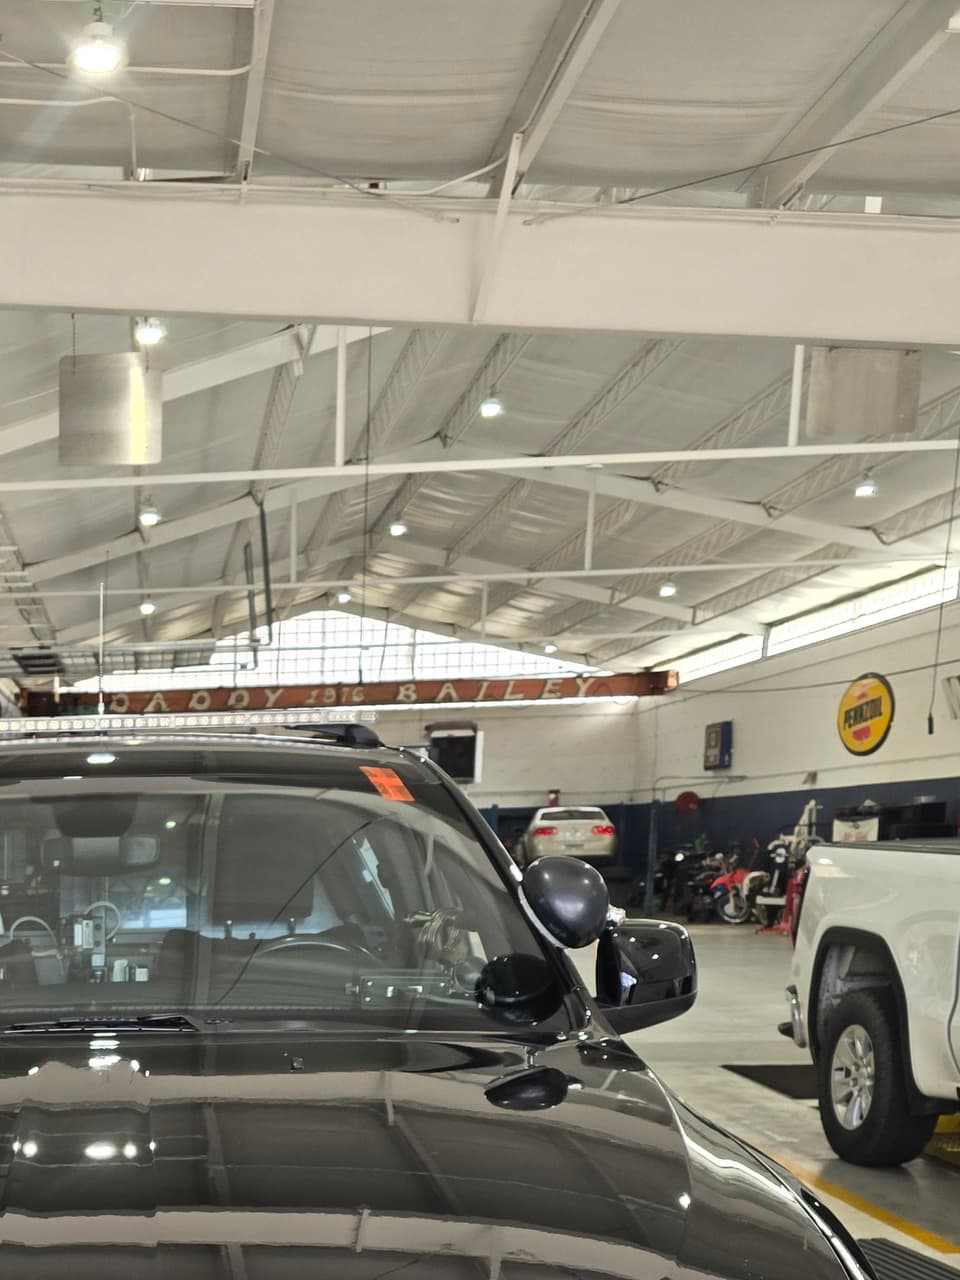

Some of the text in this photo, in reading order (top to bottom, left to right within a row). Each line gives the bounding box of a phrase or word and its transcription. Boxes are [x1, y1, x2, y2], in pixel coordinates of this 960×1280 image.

[109, 688, 283, 713] DADDY
[397, 678, 595, 702] BAILEY
[842, 696, 883, 730] PENNZOIL
